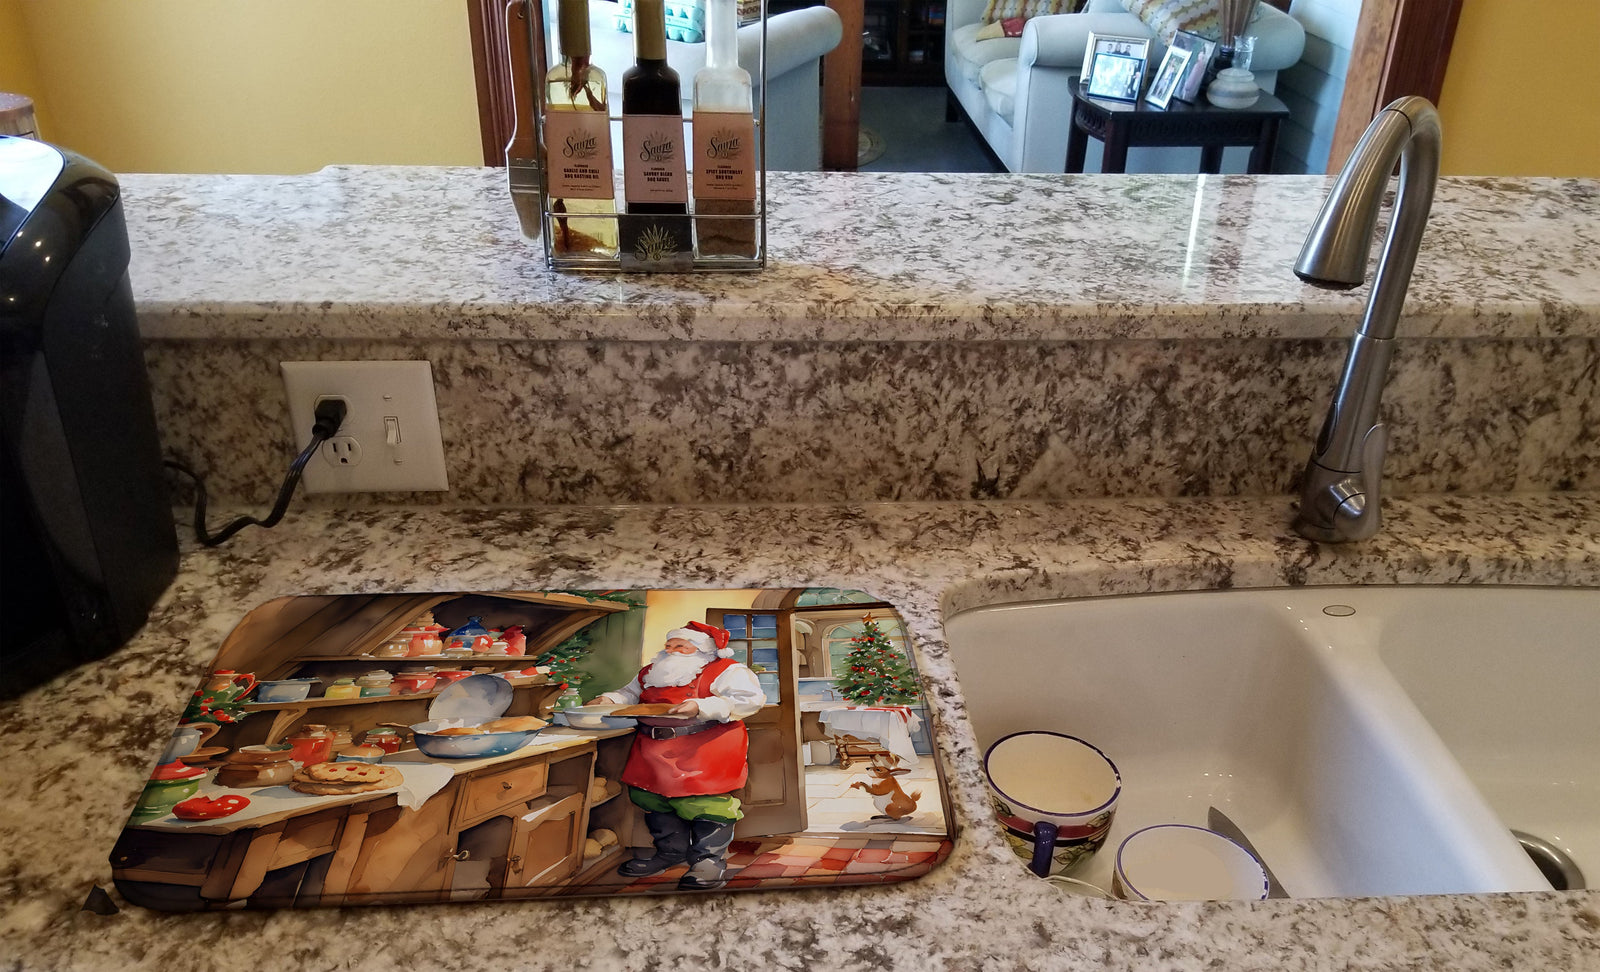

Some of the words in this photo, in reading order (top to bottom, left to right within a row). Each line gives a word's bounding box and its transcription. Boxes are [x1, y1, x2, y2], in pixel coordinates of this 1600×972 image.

[563, 136, 598, 158] Sauza
[640, 140, 674, 161] Sauza
[707, 136, 740, 158] Sauza
